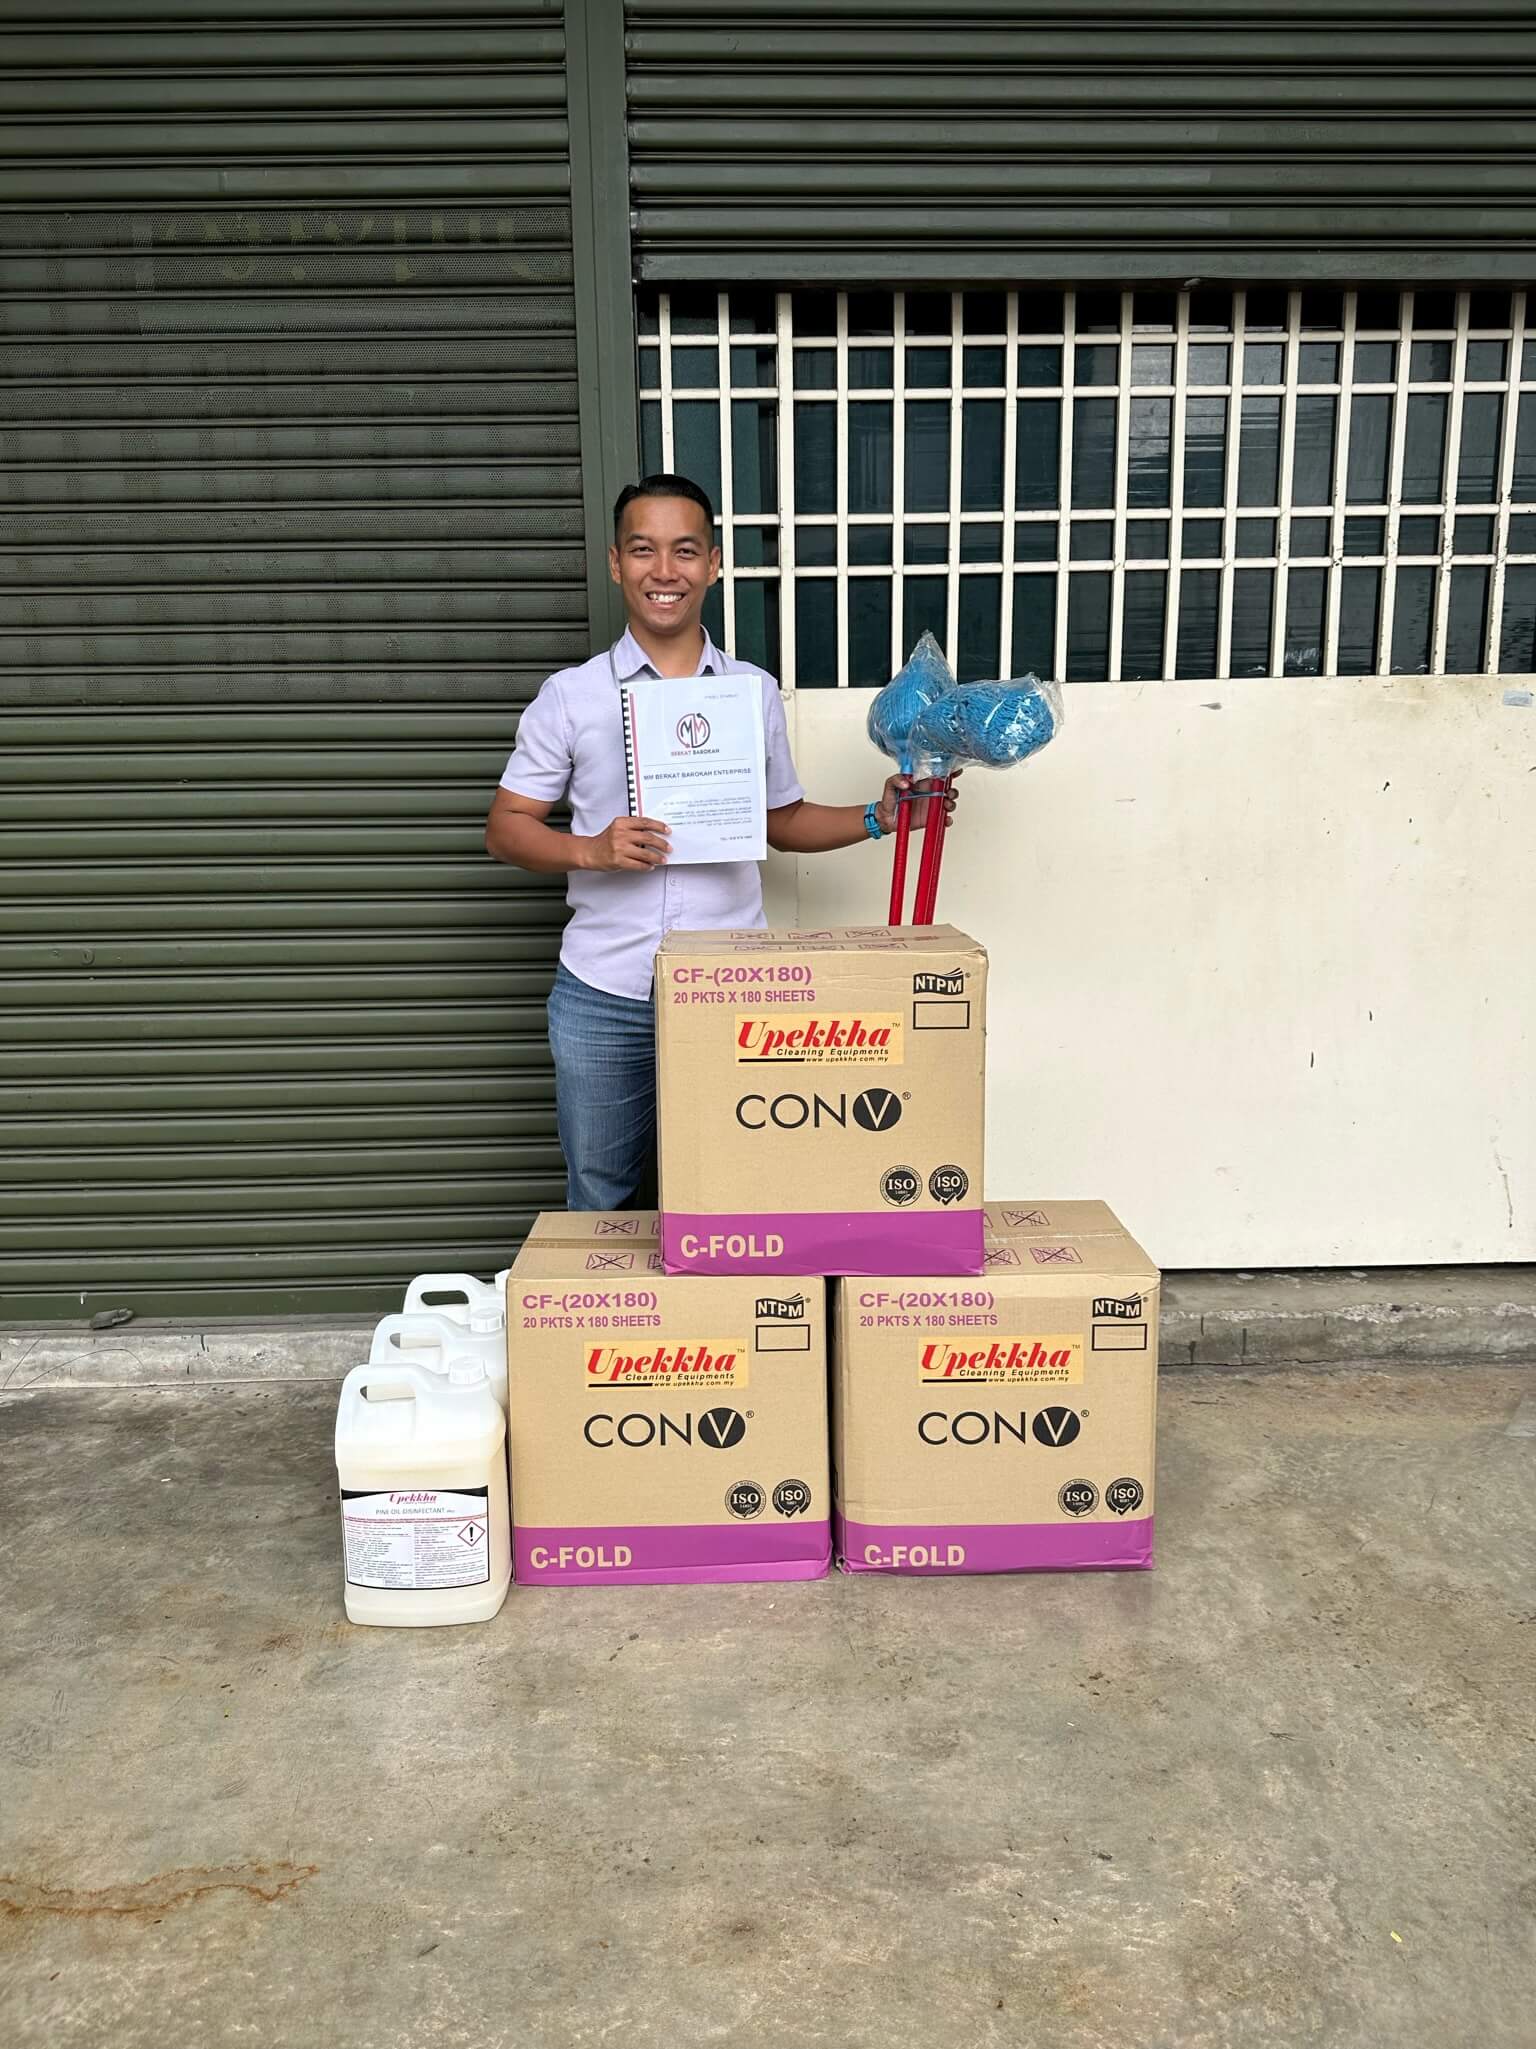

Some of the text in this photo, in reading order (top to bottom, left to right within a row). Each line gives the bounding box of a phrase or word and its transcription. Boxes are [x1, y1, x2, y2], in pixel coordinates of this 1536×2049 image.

[655, 772, 680, 780] BERKAT
[682, 770, 712, 778] BAROKAH
[714, 768, 752, 776] ENTERPRISE
[673, 966, 812, 986] CF-(20X180)
[915, 975, 961, 993] NTPM
[674, 990, 815, 1004] 20 PKTS X 180 SHEETS
[738, 1020, 890, 1055] Upekkha
[776, 1047, 889, 1057] Cleaning Equipments
[888, 1178, 914, 1191] ISO
[937, 1176, 960, 1188] ISO
[680, 1234, 784, 1258] C-FOLD
[522, 1292, 657, 1312] CF-(20X180)
[859, 1292, 994, 1310] CF-(20X180)
[757, 1301, 804, 1317] NTPM
[1094, 1300, 1141, 1317] NTPM
[523, 1314, 661, 1328] 20 PKTS X 180 SHEETS
[860, 1314, 998, 1326] 20 PKTS X 180 SHEETS
[587, 1347, 736, 1381] Upekkha
[922, 1343, 1070, 1378] Upekkha
[625, 1372, 735, 1382] Cleaning Equipments
[959, 1368, 1069, 1377] Cleaning Equipments
[389, 1493, 437, 1504] Upekkha
[733, 1493, 758, 1504] ISO
[781, 1490, 804, 1501] ISO
[1066, 1491, 1092, 1502] ISO
[1114, 1488, 1136, 1499] ISO
[530, 1545, 632, 1568] C-FOLD
[864, 1545, 965, 1567] C-FOLD
